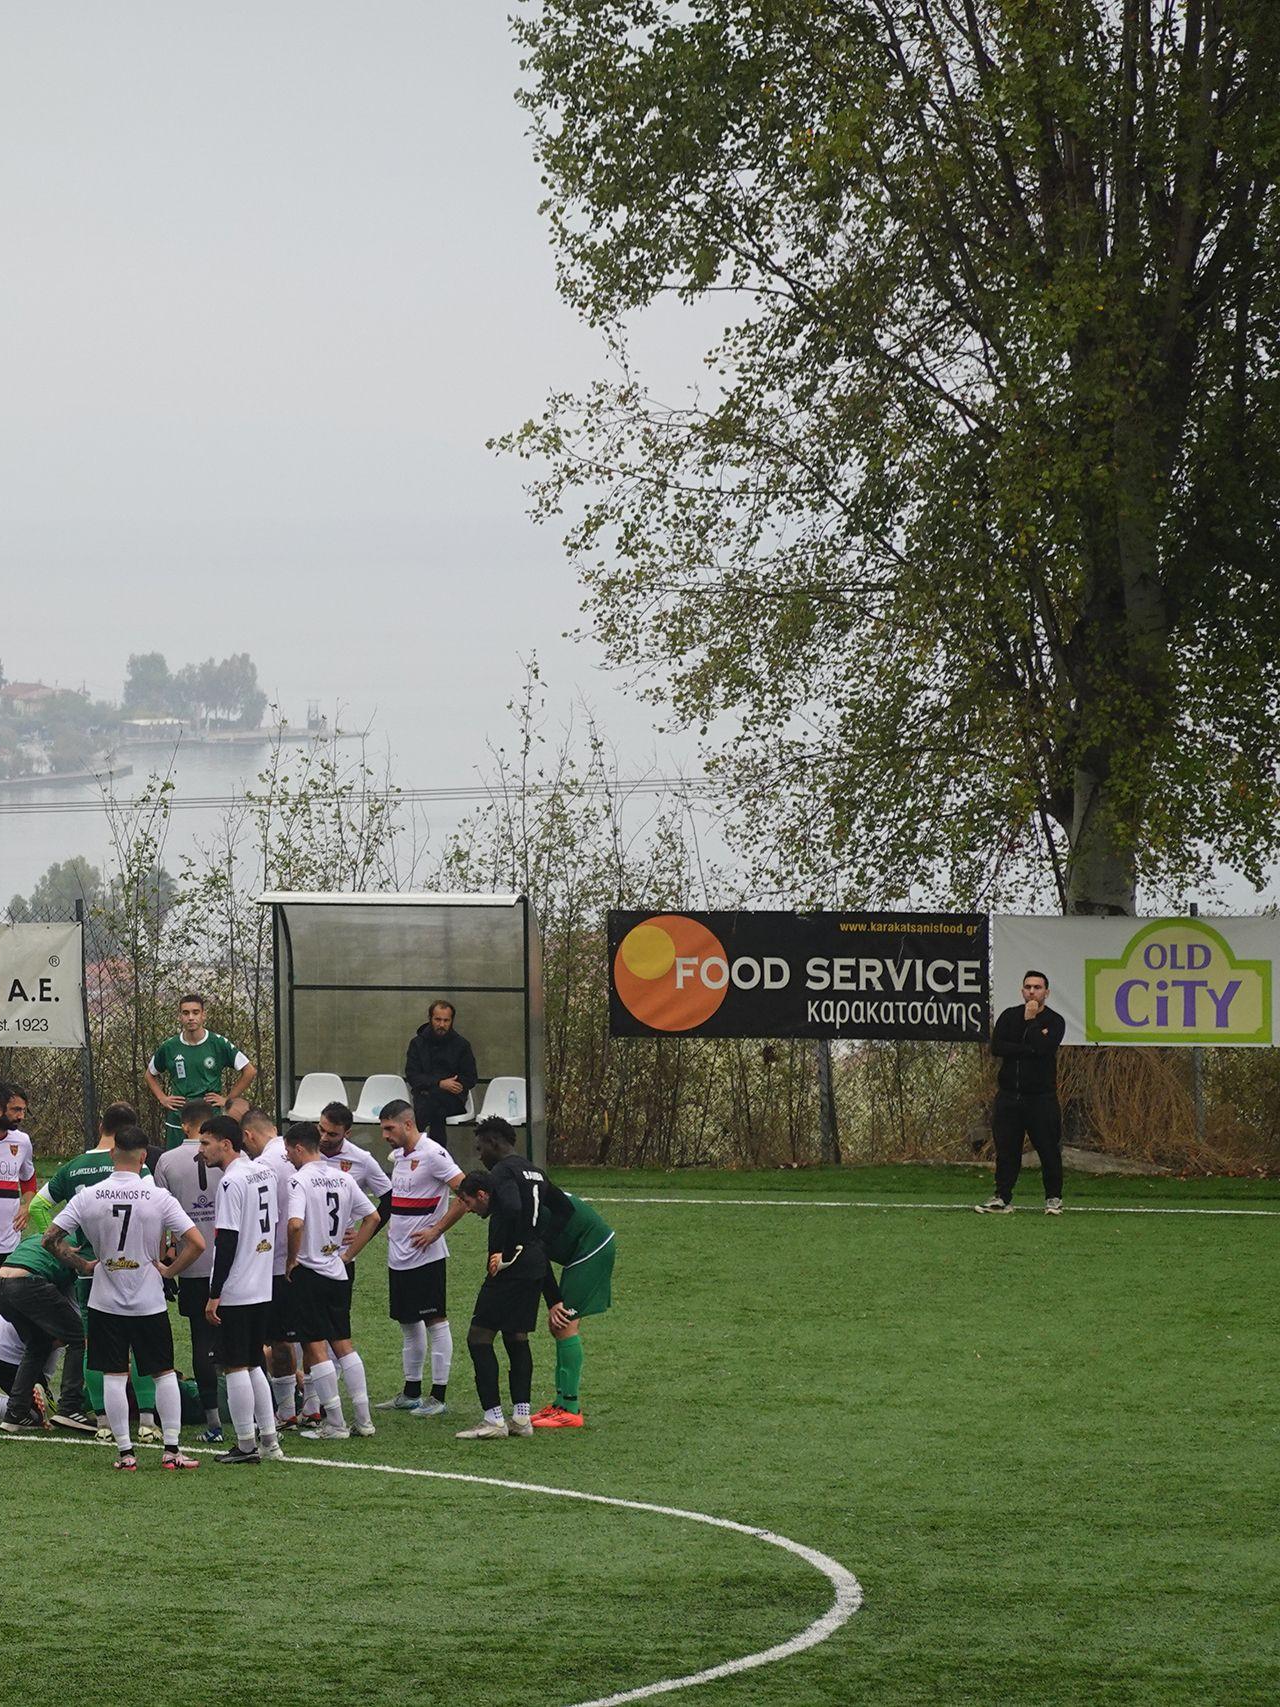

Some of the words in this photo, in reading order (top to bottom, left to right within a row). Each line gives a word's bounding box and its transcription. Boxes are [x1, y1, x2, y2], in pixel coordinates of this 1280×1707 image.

[675, 956, 790, 990] FOOD
[805, 957, 982, 993] SERVICE
[1143, 943, 1212, 970] OLD
[7, 978, 60, 1003] Α.Ε.
[15, 1018, 49, 1032] 1923
[807, 996, 982, 1033] καρακατσάνης
[95, 1189, 139, 1200] SARAKINOS
[140, 1190, 151, 1200] FC
[257, 1185, 271, 1234] 5
[112, 1203, 133, 1252] 7
[326, 1191, 340, 1237] 3
